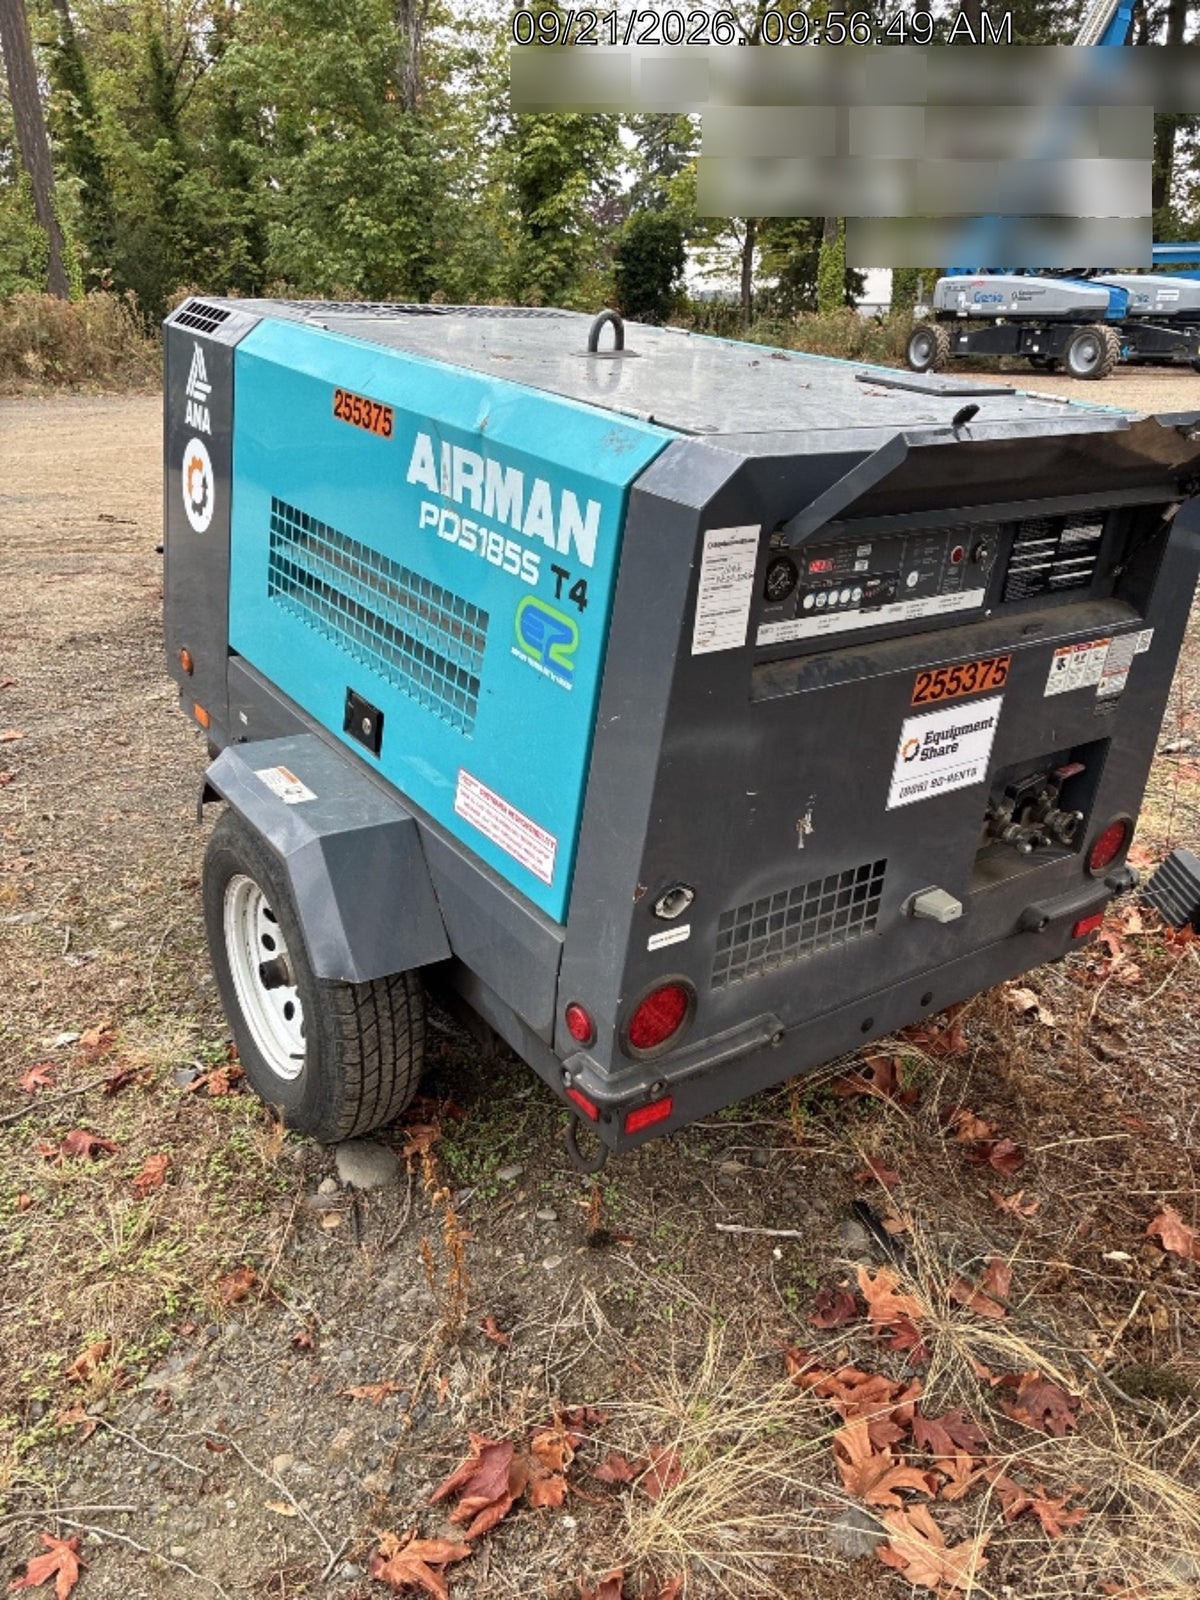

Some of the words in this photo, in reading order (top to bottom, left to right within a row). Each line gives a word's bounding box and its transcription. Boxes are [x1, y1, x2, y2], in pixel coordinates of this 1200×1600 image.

[974, 290, 1004, 303] Genie
[334, 388, 393, 437] 255375
[406, 431, 602, 569] AIRMAN
[418, 501, 541, 587] PDS185S
[551, 563, 588, 613] T4
[913, 657, 1009, 703] 255375
[919, 742, 960, 762] Share
[923, 716, 995, 746] Equipment
